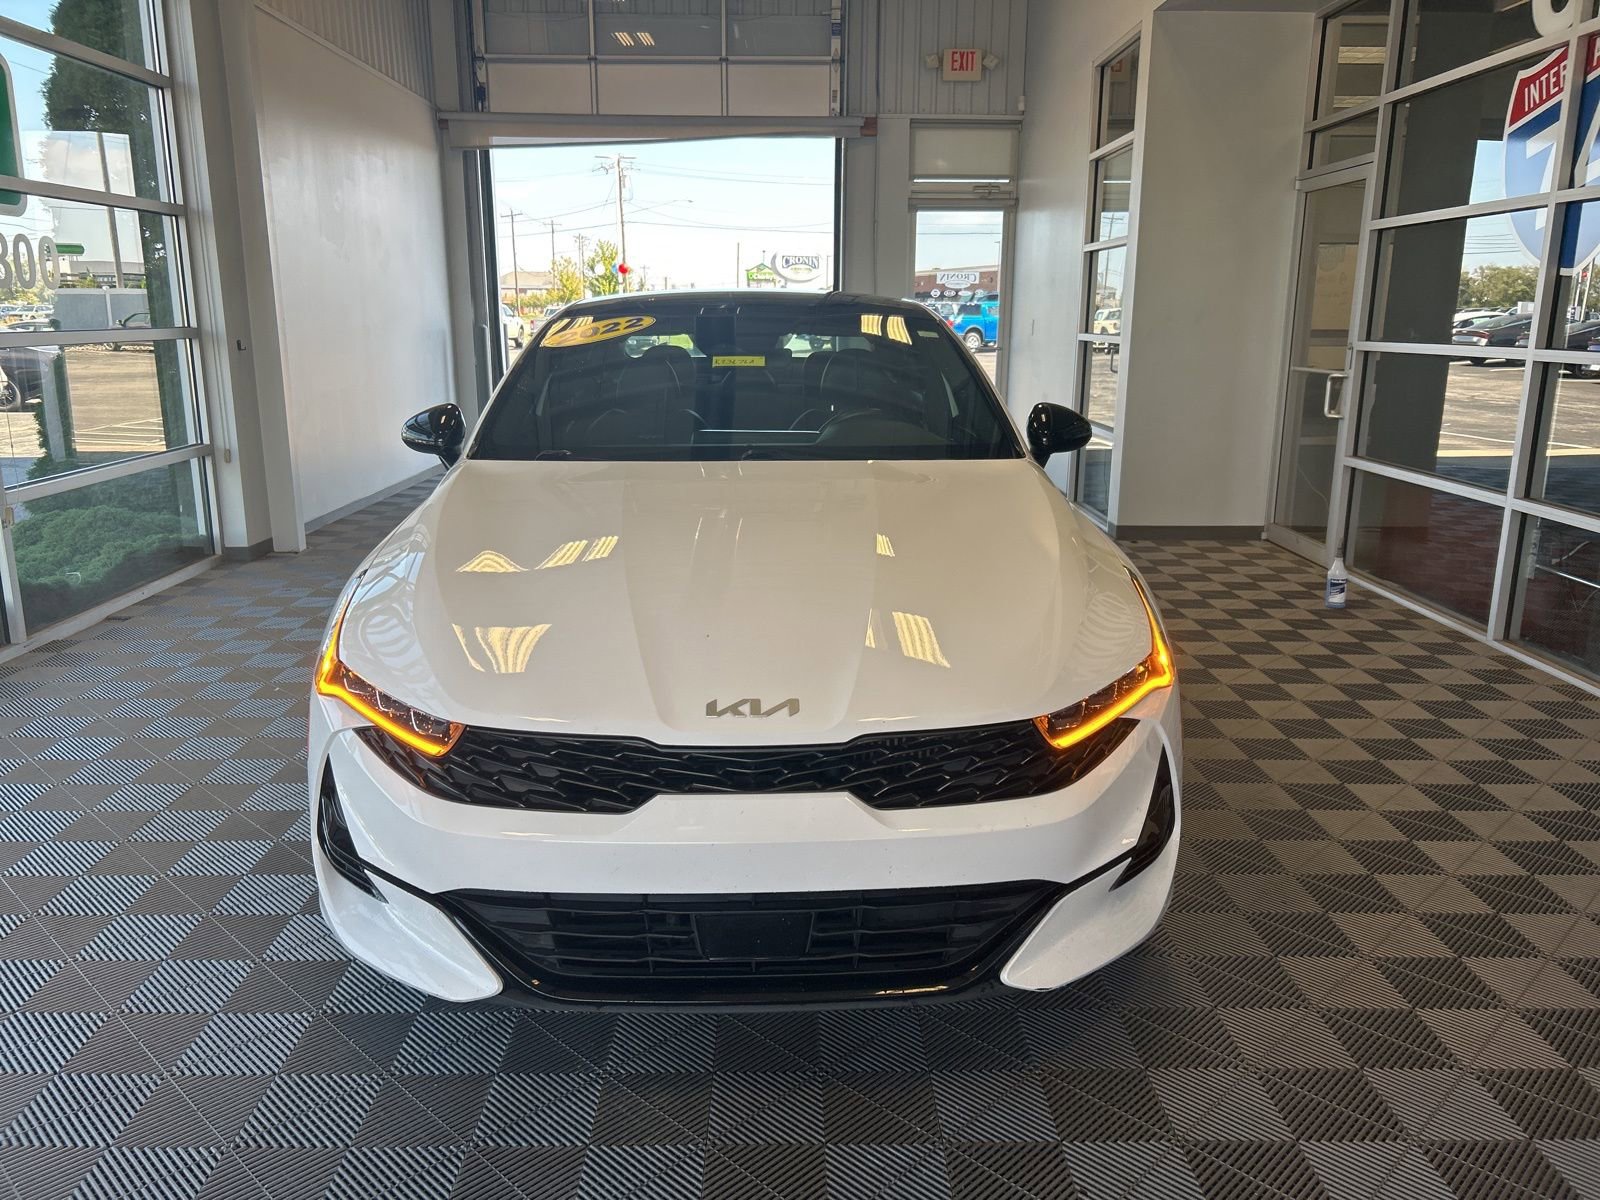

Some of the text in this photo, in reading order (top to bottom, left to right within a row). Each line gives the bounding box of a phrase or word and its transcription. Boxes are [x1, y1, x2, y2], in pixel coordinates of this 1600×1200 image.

[951, 51, 976, 71] EXIT
[782, 256, 820, 269] CRONIN
[553, 317, 645, 345] 2022
[705, 698, 800, 718] KIA
